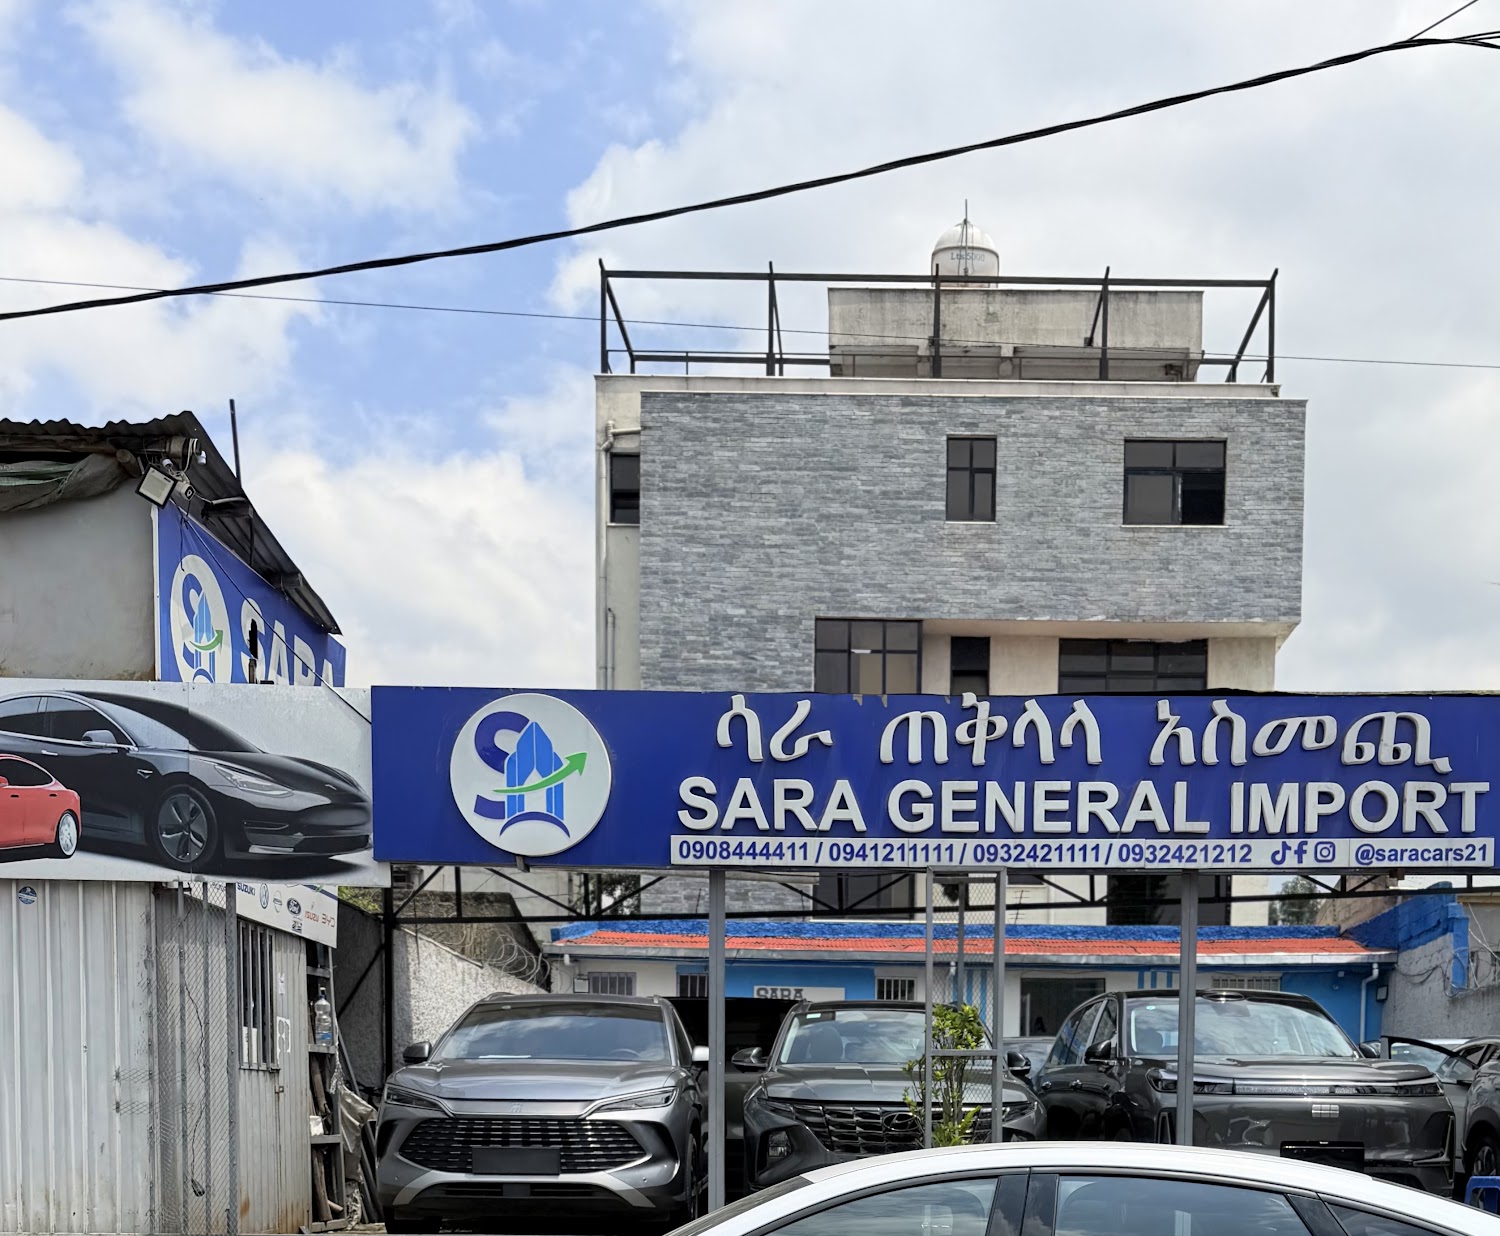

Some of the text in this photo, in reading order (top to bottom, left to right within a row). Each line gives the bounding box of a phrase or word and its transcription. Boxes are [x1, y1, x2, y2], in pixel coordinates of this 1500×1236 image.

[716, 692, 1453, 775] ሳራ ጠቅላላ አስመጪ
[677, 776, 1491, 835] SARA GENERAL IMPORT
[679, 840, 809, 861] 0908444411
[829, 842, 954, 862] 0941211111
[973, 842, 1100, 863] 0932421111
[1118, 843, 1253, 864] 0932421212
[1355, 843, 1487, 866] @saracars21
